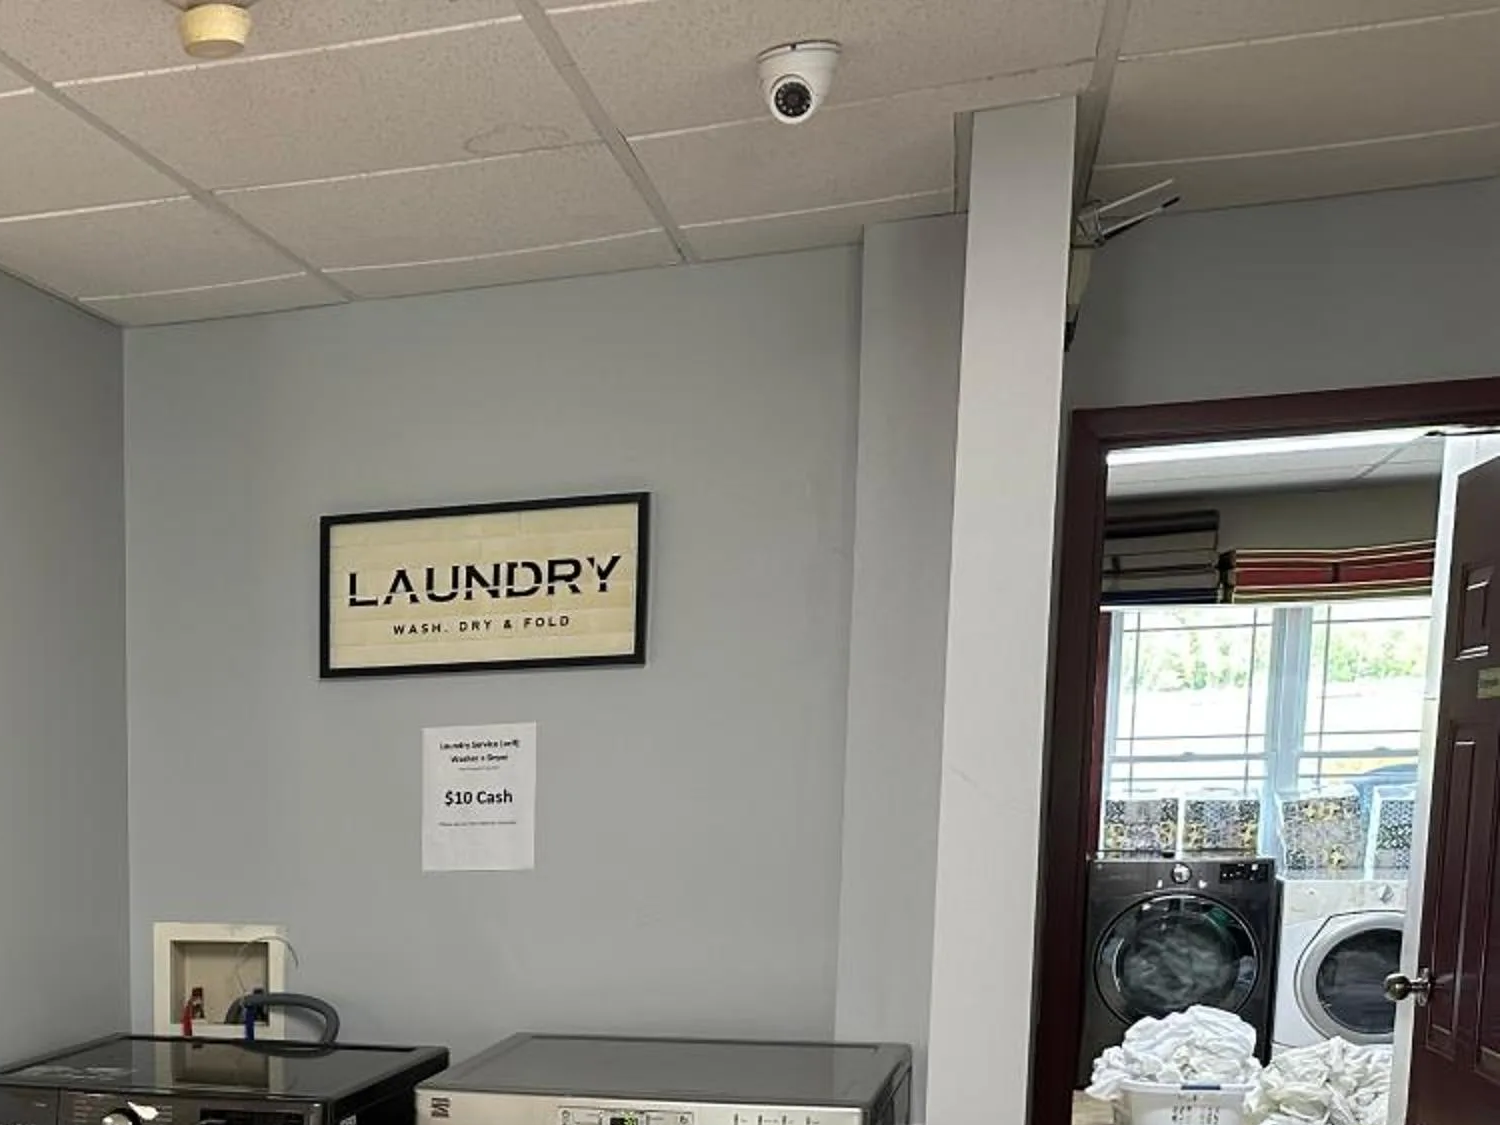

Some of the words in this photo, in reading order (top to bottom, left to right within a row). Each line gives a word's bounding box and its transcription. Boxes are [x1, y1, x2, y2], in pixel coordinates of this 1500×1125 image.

[348, 555, 622, 607] LAUNDRY
[459, 619, 493, 632] DRY
[503, 618, 513, 630] &
[524, 615, 570, 628] FOLD
[439, 741, 470, 751] Laundry
[471, 740, 498, 750] Service
[445, 790, 473, 807] $10
[476, 788, 513, 805] Cash
